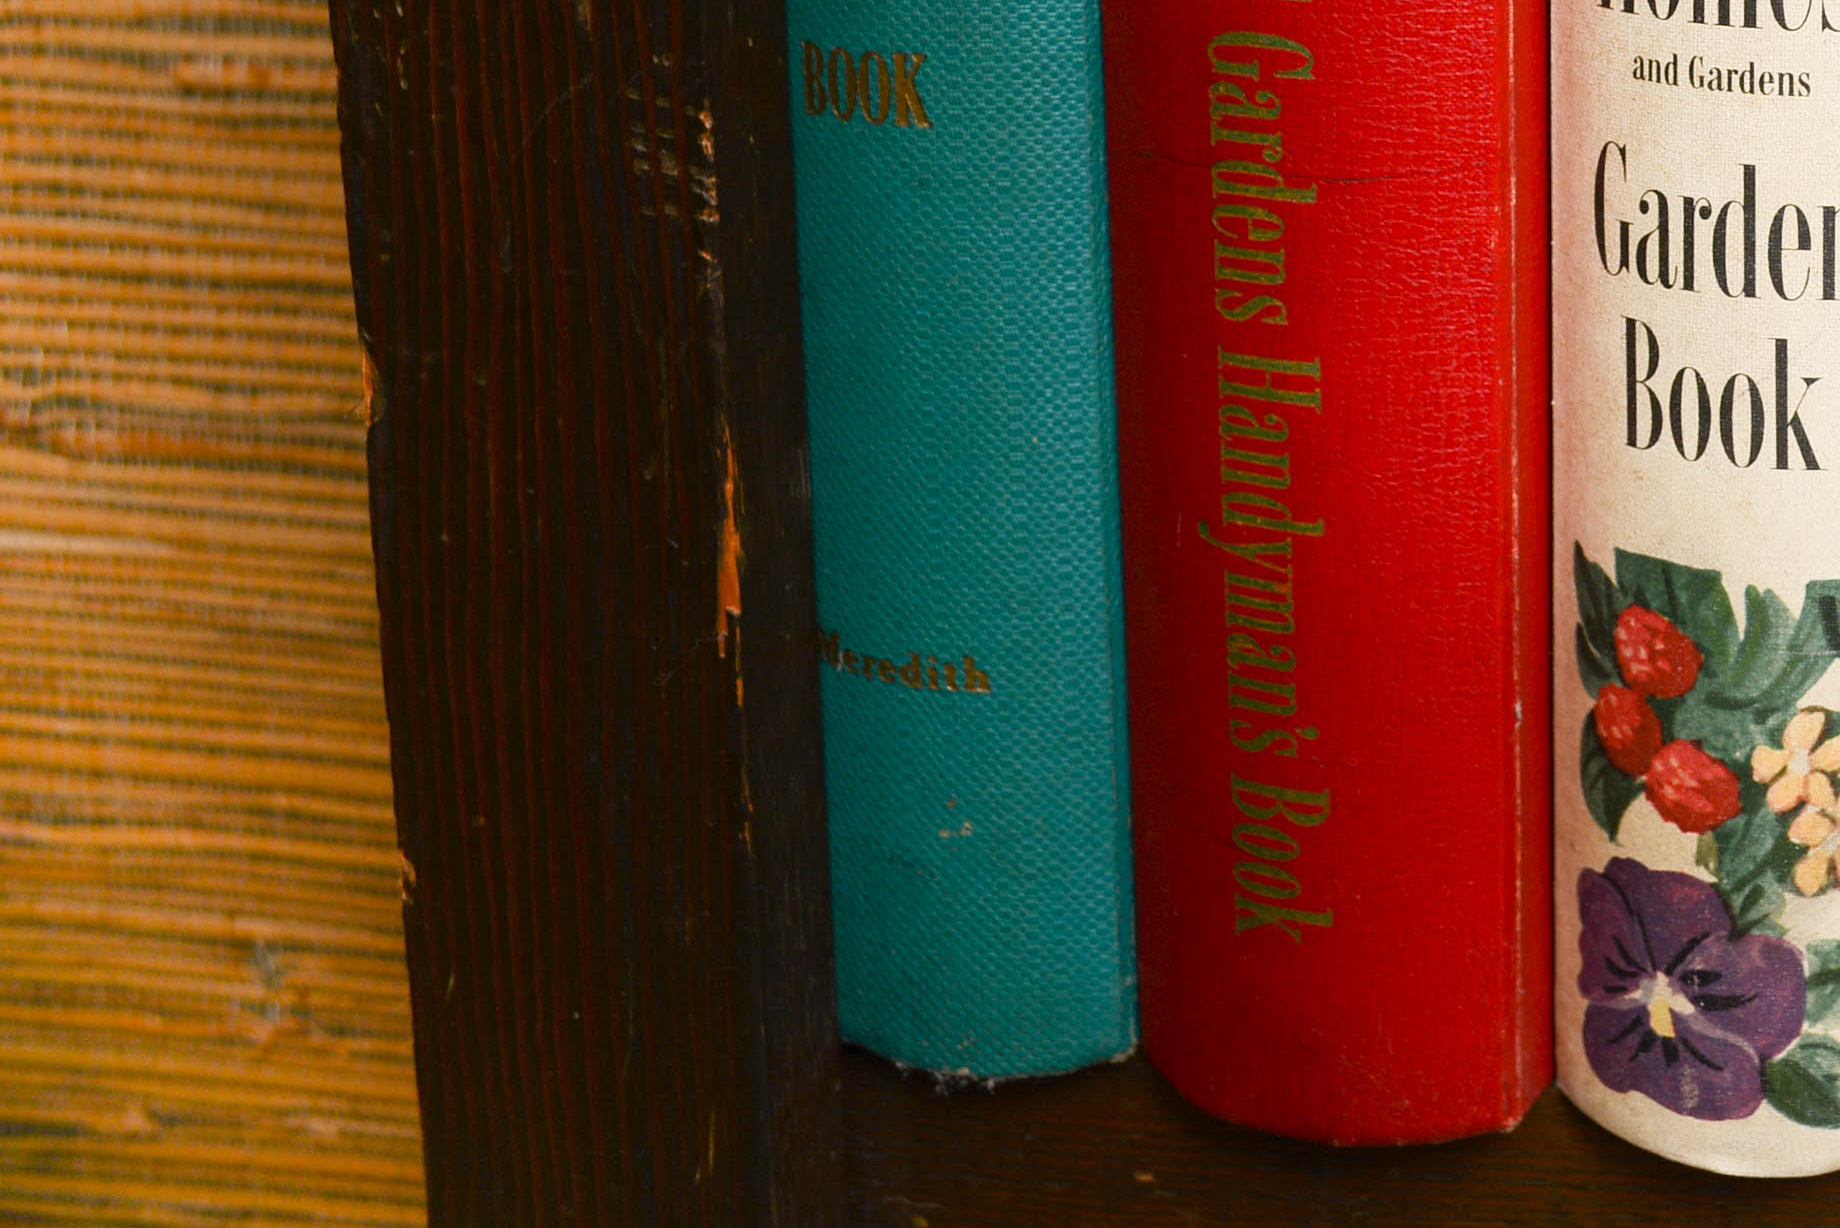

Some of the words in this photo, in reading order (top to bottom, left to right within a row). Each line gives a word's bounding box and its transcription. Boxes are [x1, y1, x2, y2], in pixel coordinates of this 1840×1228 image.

[800, 40, 933, 128] BOOK
[1632, 52, 1679, 87] and
[1688, 55, 1812, 97] Gardens
[1207, 31, 1318, 326] Gardens
[1621, 316, 1829, 473] Book
[1198, 344, 1326, 759] Handyman's
[816, 626, 992, 693] Meredith
[1230, 772, 1334, 945] Book
